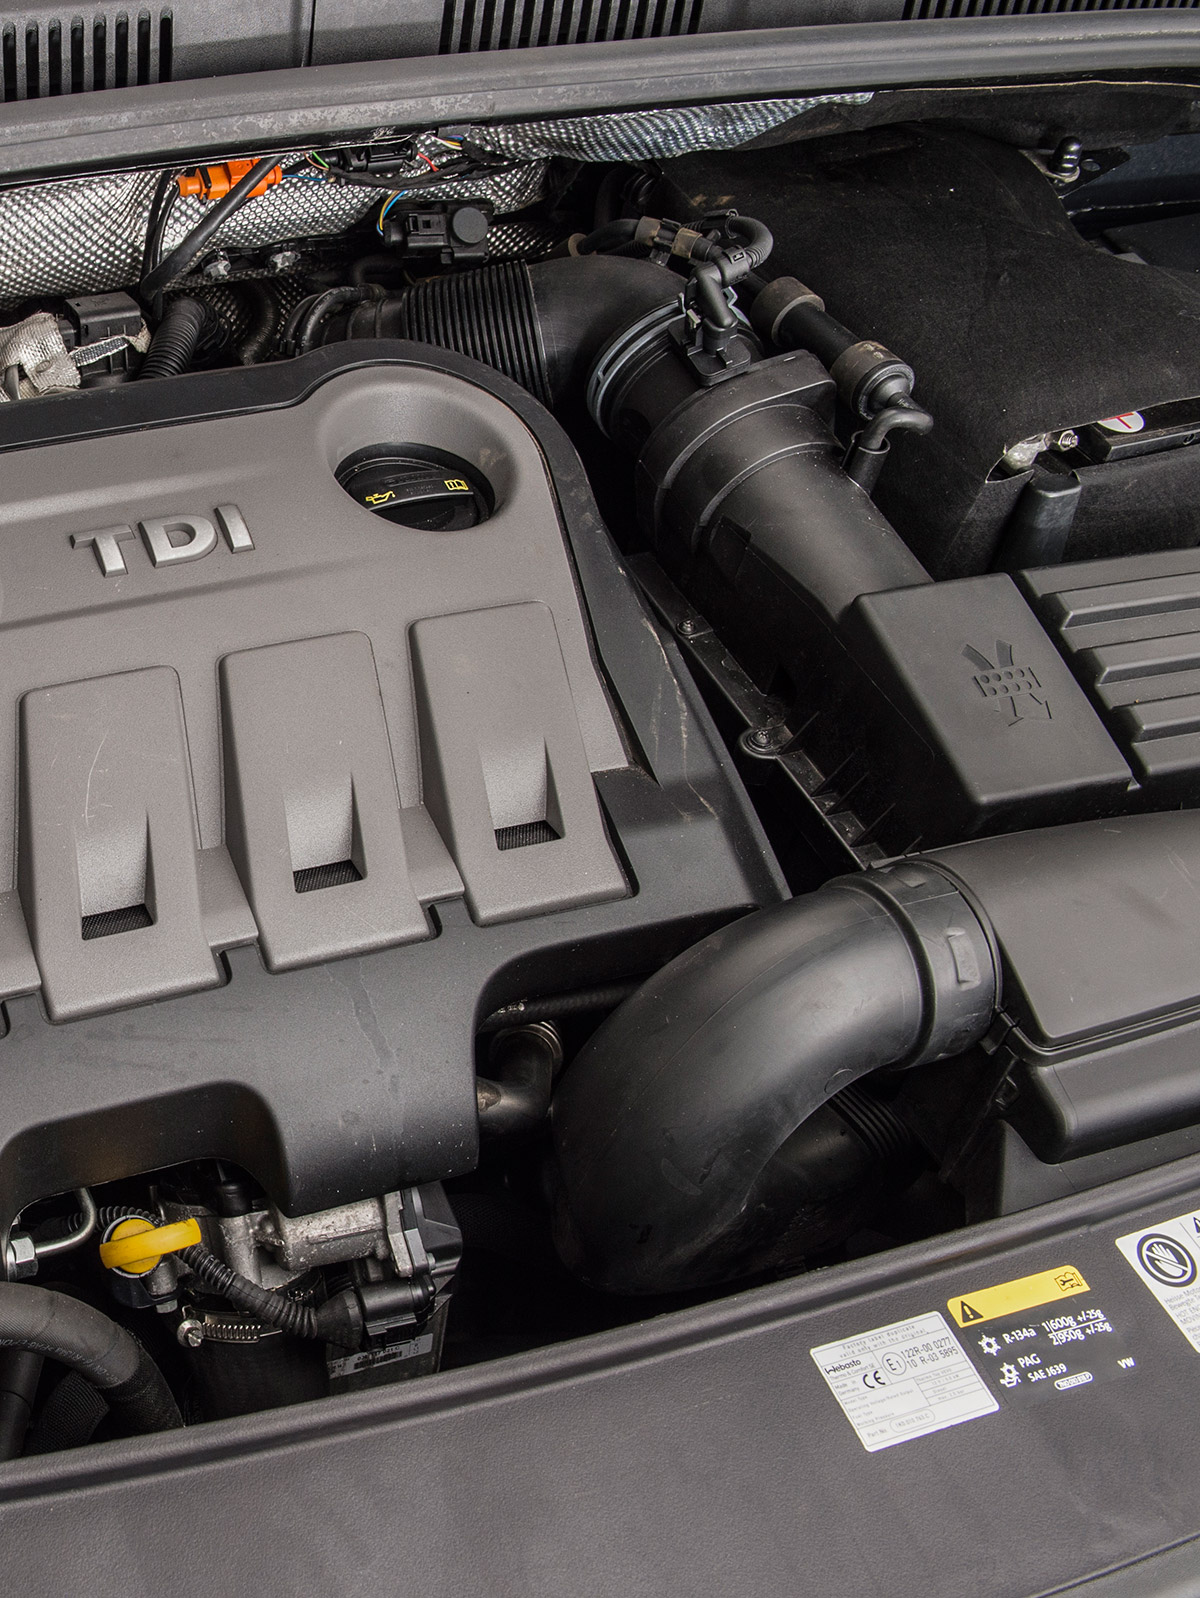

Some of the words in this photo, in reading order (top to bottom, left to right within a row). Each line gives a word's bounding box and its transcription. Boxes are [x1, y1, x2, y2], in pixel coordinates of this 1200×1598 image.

[69, 504, 255, 577] TDI
[1003, 1328, 1036, 1343] R-134a
[1077, 1309, 1104, 1321] +/-25g
[1086, 1319, 1112, 1334] +/-25g
[901, 1343, 933, 1358] 122R-00
[933, 1337, 951, 1348] 0277
[906, 1359, 918, 1368] 10
[919, 1352, 939, 1364] R-03
[939, 1346, 958, 1358] 5895
[824, 1360, 861, 1374] Webasto
[1017, 1353, 1040, 1367] PAG
[1028, 1369, 1046, 1382] SAE
[1046, 1363, 1066, 1376] J639
[1117, 1357, 1135, 1369] VW
[863, 1371, 885, 1388] CE
[838, 1387, 859, 1396] Germany
